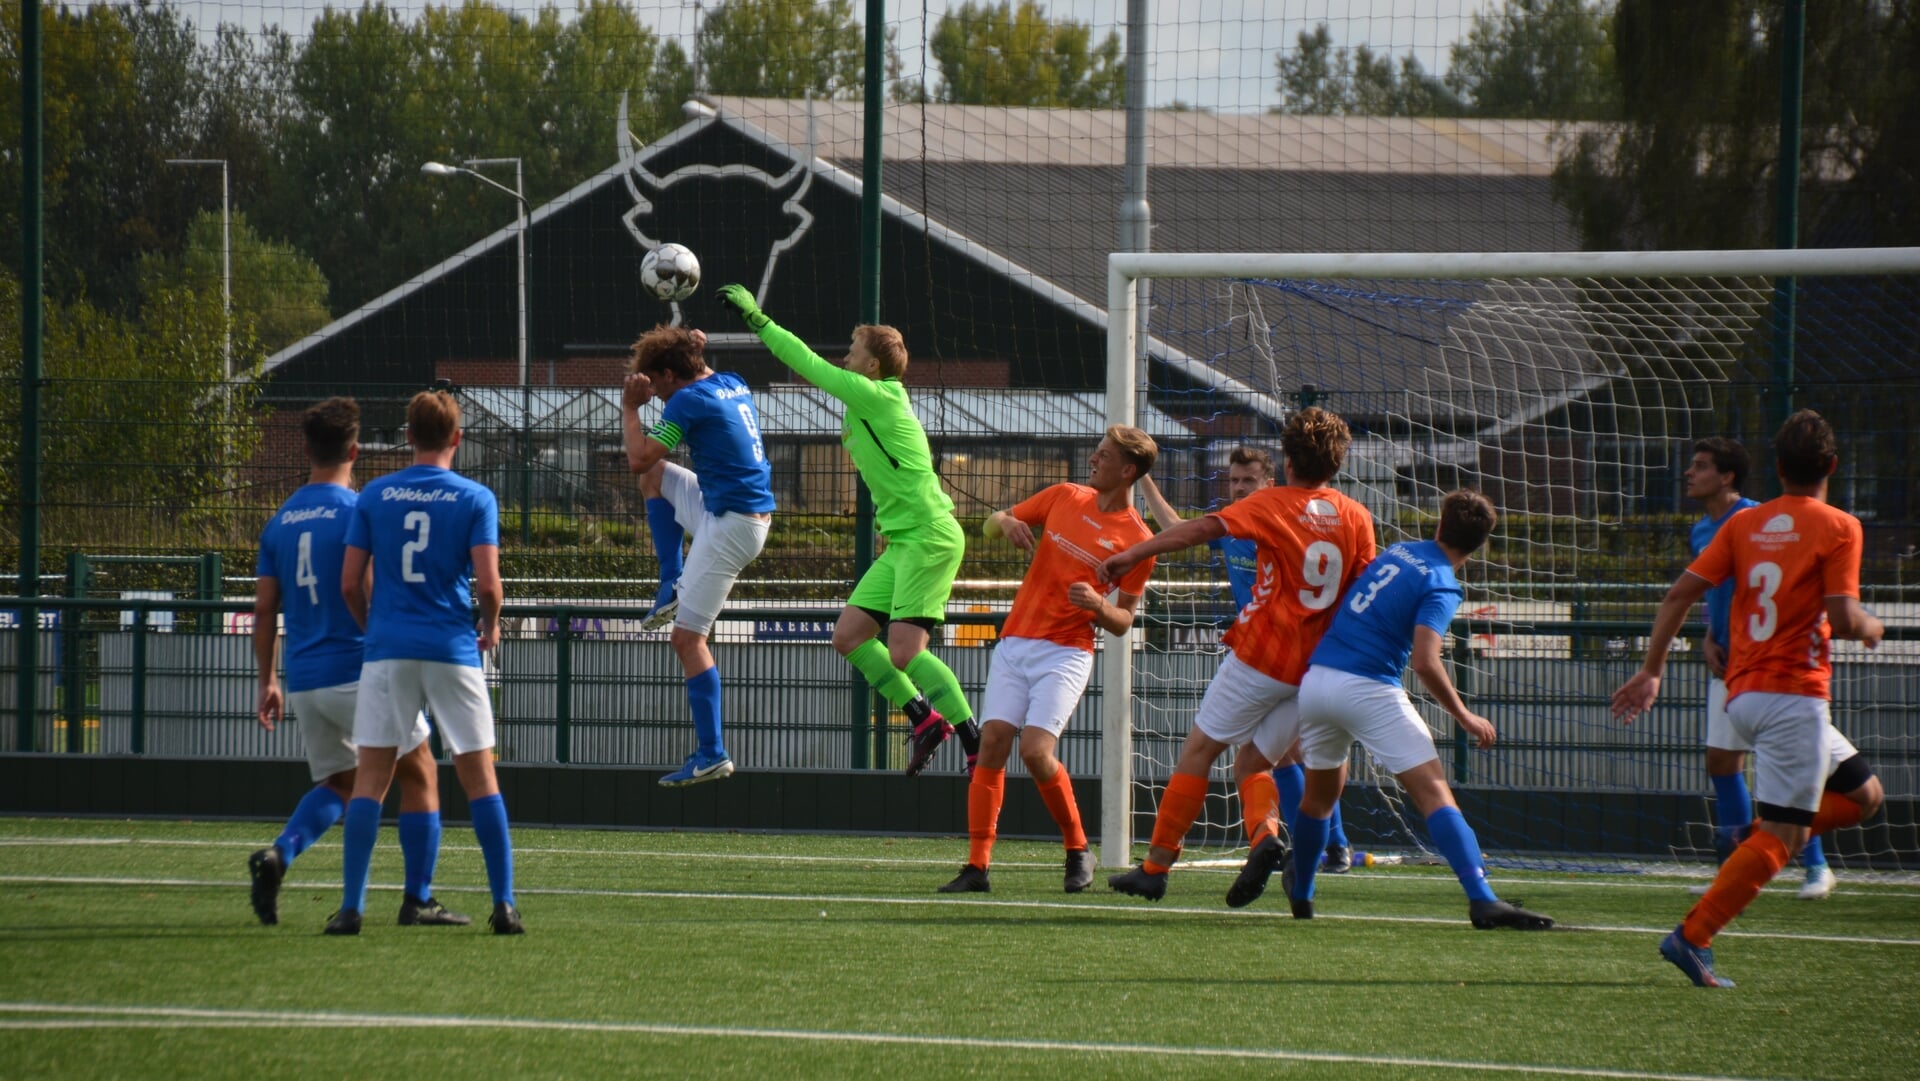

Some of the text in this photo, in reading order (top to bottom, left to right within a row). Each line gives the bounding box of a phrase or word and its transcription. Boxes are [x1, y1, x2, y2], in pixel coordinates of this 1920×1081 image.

[296, 532, 318, 605] 4
[402, 511, 430, 582] 2
[1298, 541, 1344, 609] 9
[1350, 564, 1400, 613] 3
[1749, 561, 1782, 642] 3
